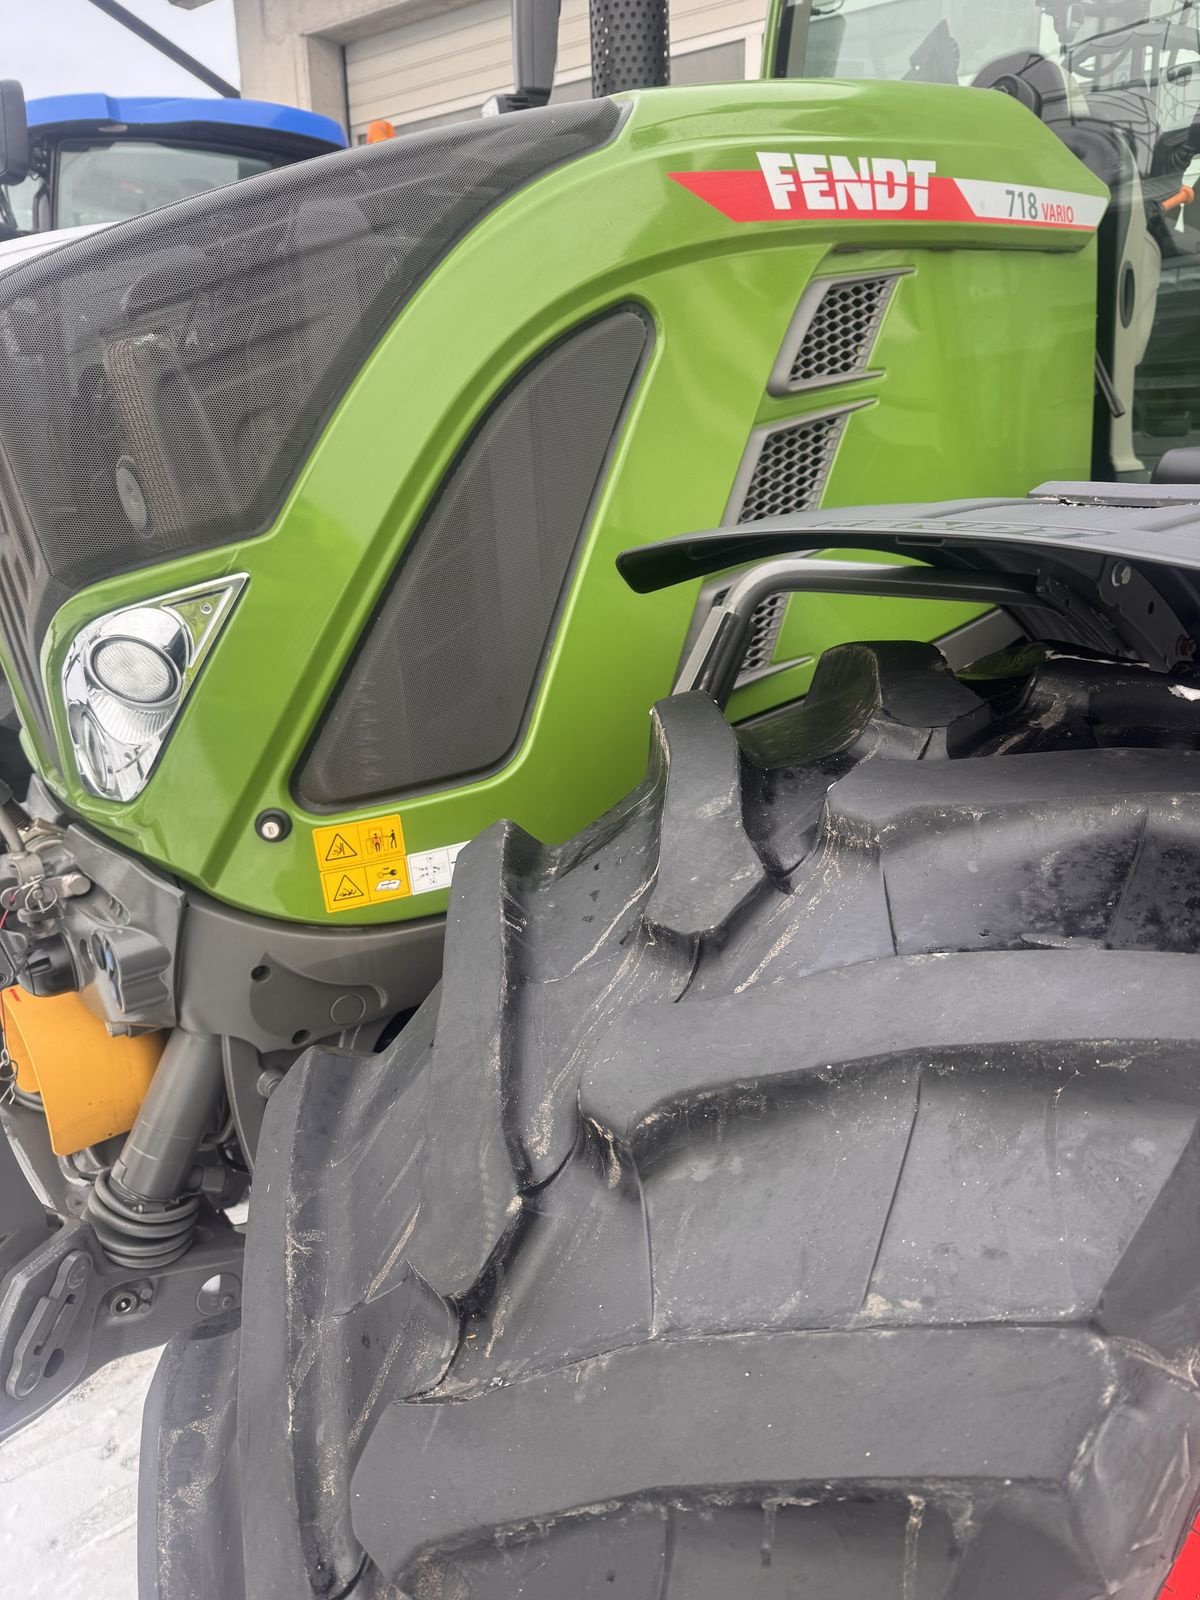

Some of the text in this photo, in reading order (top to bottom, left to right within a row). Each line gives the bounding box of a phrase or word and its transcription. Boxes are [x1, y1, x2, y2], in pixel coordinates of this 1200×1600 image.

[756, 152, 936, 211] FENDT
[1005, 190, 1074, 223] 718 VARIO
